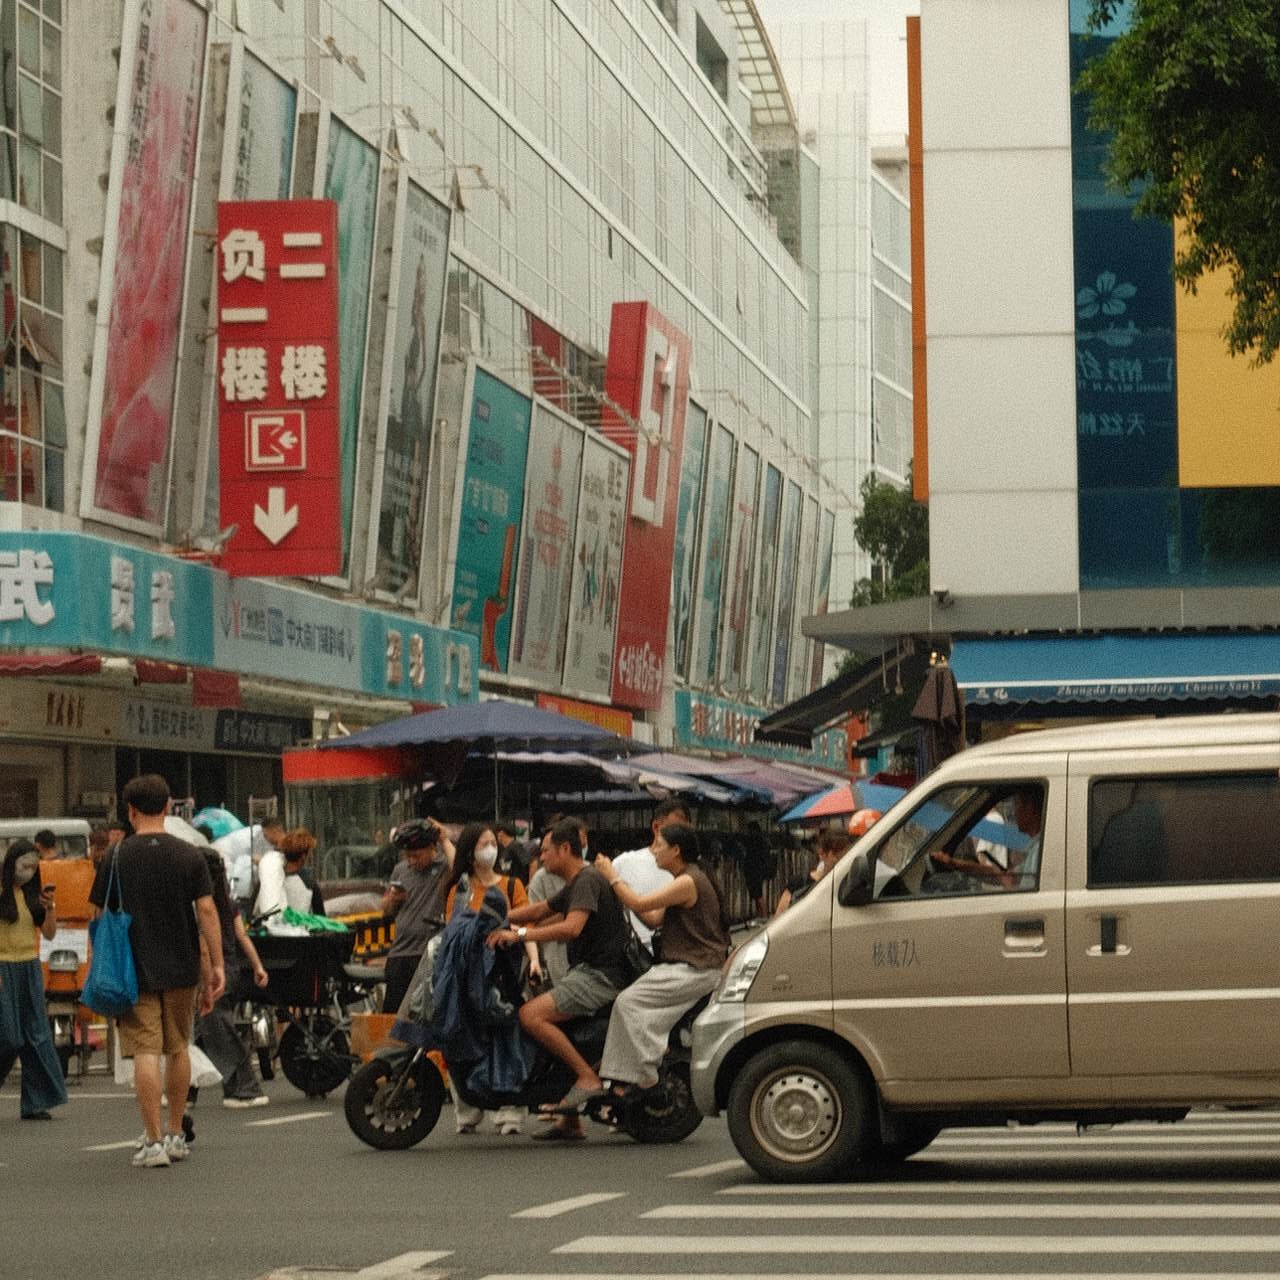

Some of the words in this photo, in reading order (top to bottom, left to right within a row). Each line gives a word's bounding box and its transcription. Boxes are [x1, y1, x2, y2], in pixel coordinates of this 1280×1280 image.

[220, 228, 269, 402] 负一楼
[872, 938, 921, 969] 核载7人
